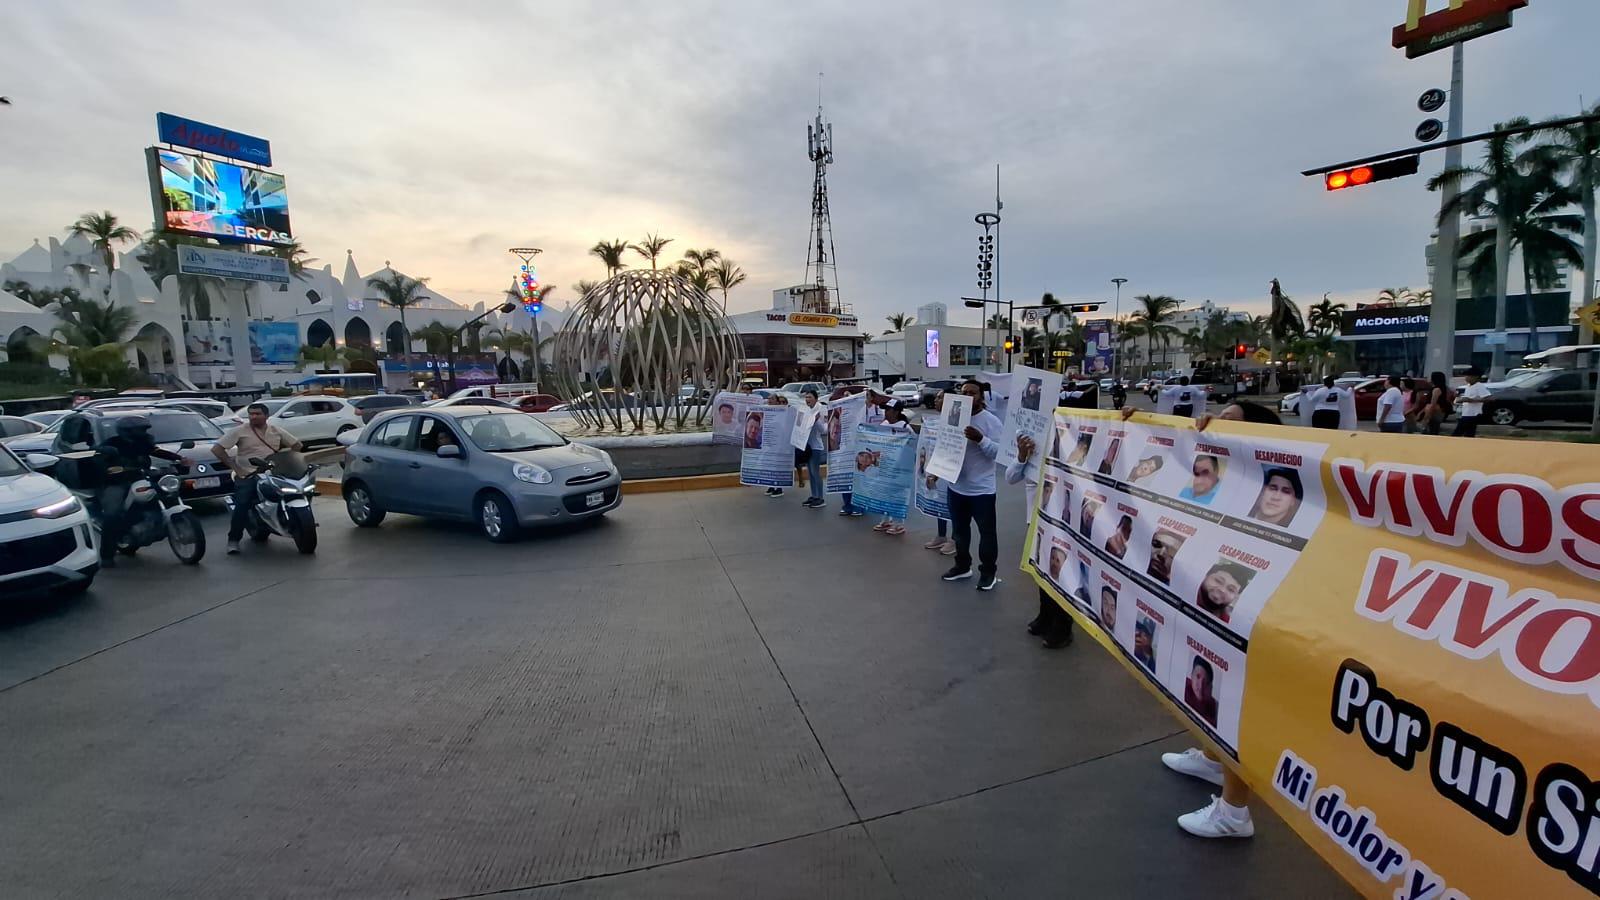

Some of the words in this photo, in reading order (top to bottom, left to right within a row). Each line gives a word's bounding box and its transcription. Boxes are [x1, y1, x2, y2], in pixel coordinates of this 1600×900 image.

[1430, 22, 1483, 44] AutoMac
[1423, 92, 1439, 105] 24
[170, 122, 241, 152] Apolo
[766, 313, 786, 321] TACOS
[1355, 315, 1429, 327] McDonald's
[1254, 450, 1302, 467] DESAPARECIDO
[1157, 515, 1198, 536] DESAPARECIDO
[1218, 543, 1270, 570] DESAPARECIDO
[1186, 635, 1228, 672] DESAPARECIDO
[1337, 668, 1421, 757] Por
[1439, 736, 1516, 820] un
[1277, 756, 1312, 803] Mi
[1315, 793, 1403, 874] dolor
